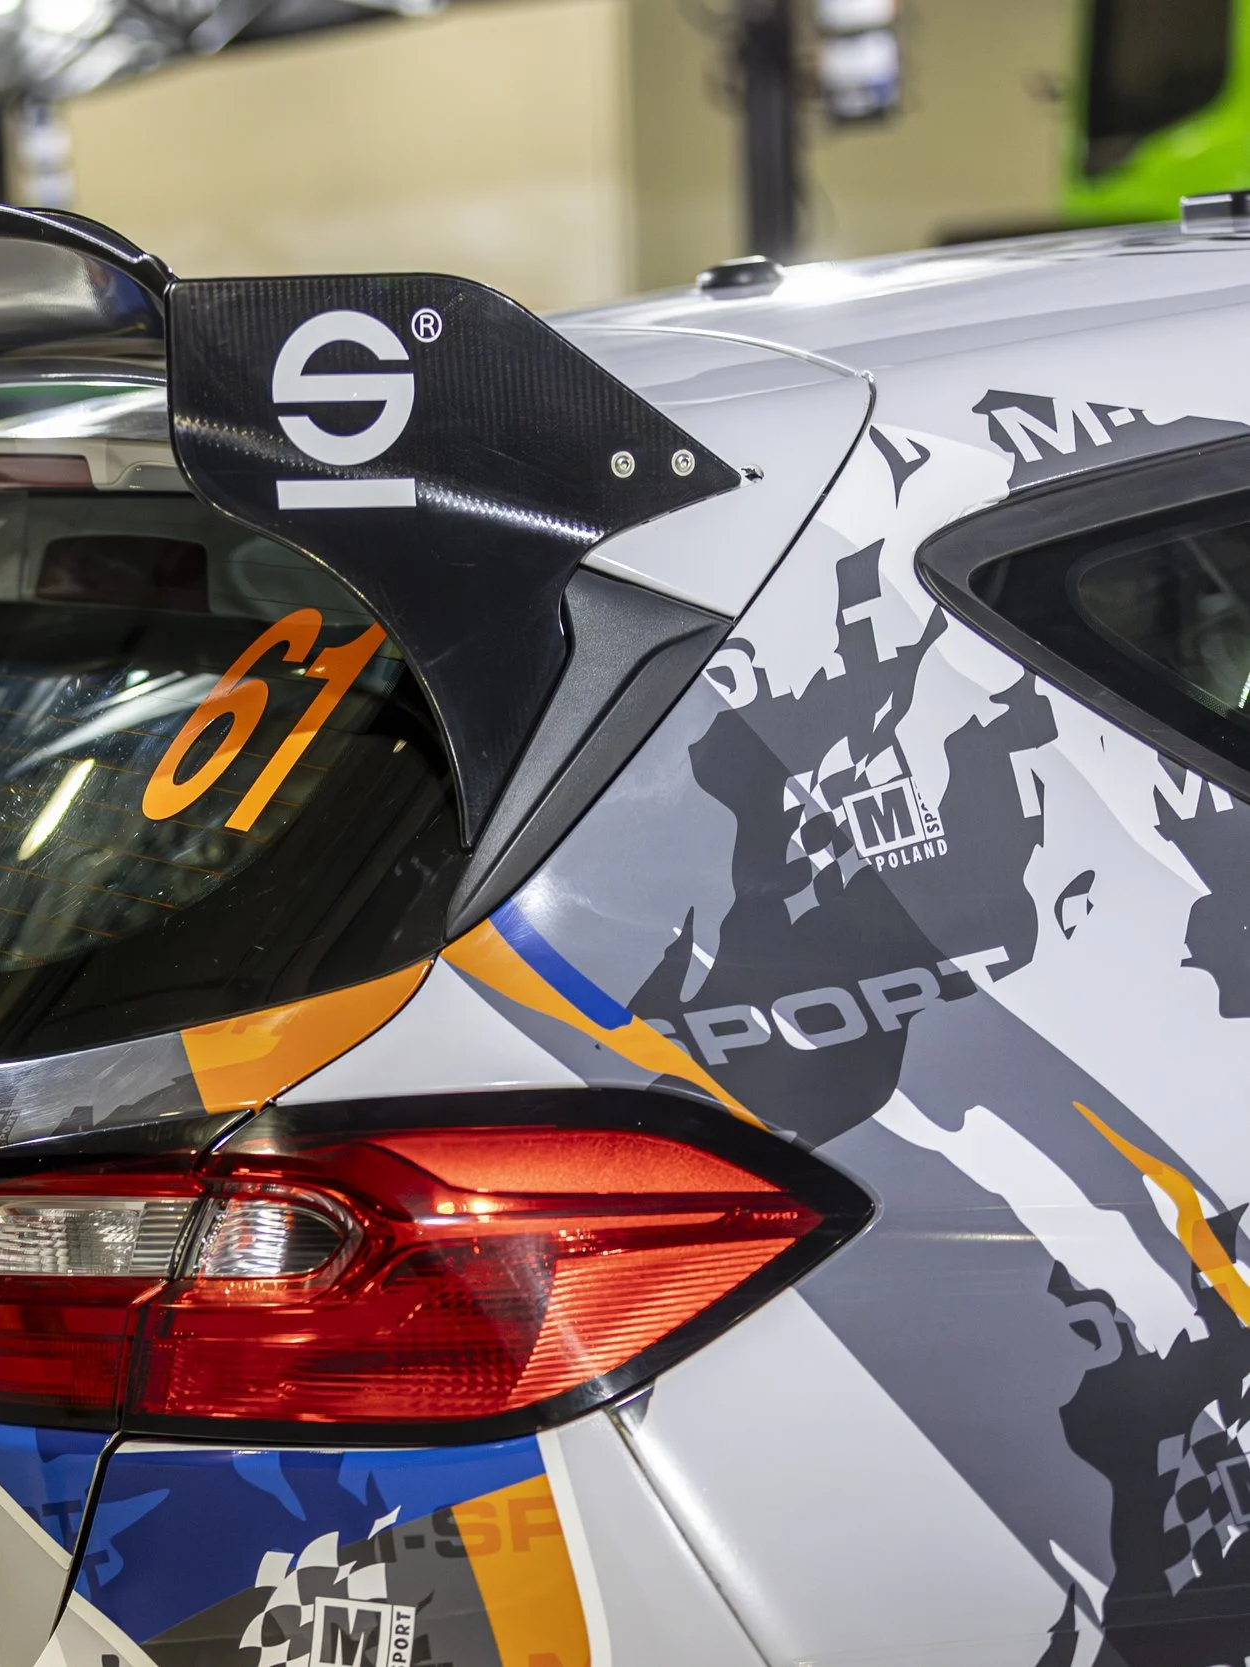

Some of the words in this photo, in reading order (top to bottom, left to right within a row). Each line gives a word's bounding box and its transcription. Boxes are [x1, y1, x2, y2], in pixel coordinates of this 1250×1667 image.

[142, 608, 387, 832] 61
[875, 839, 948, 872] POLAND
[391, 1611, 411, 1667] PORT
